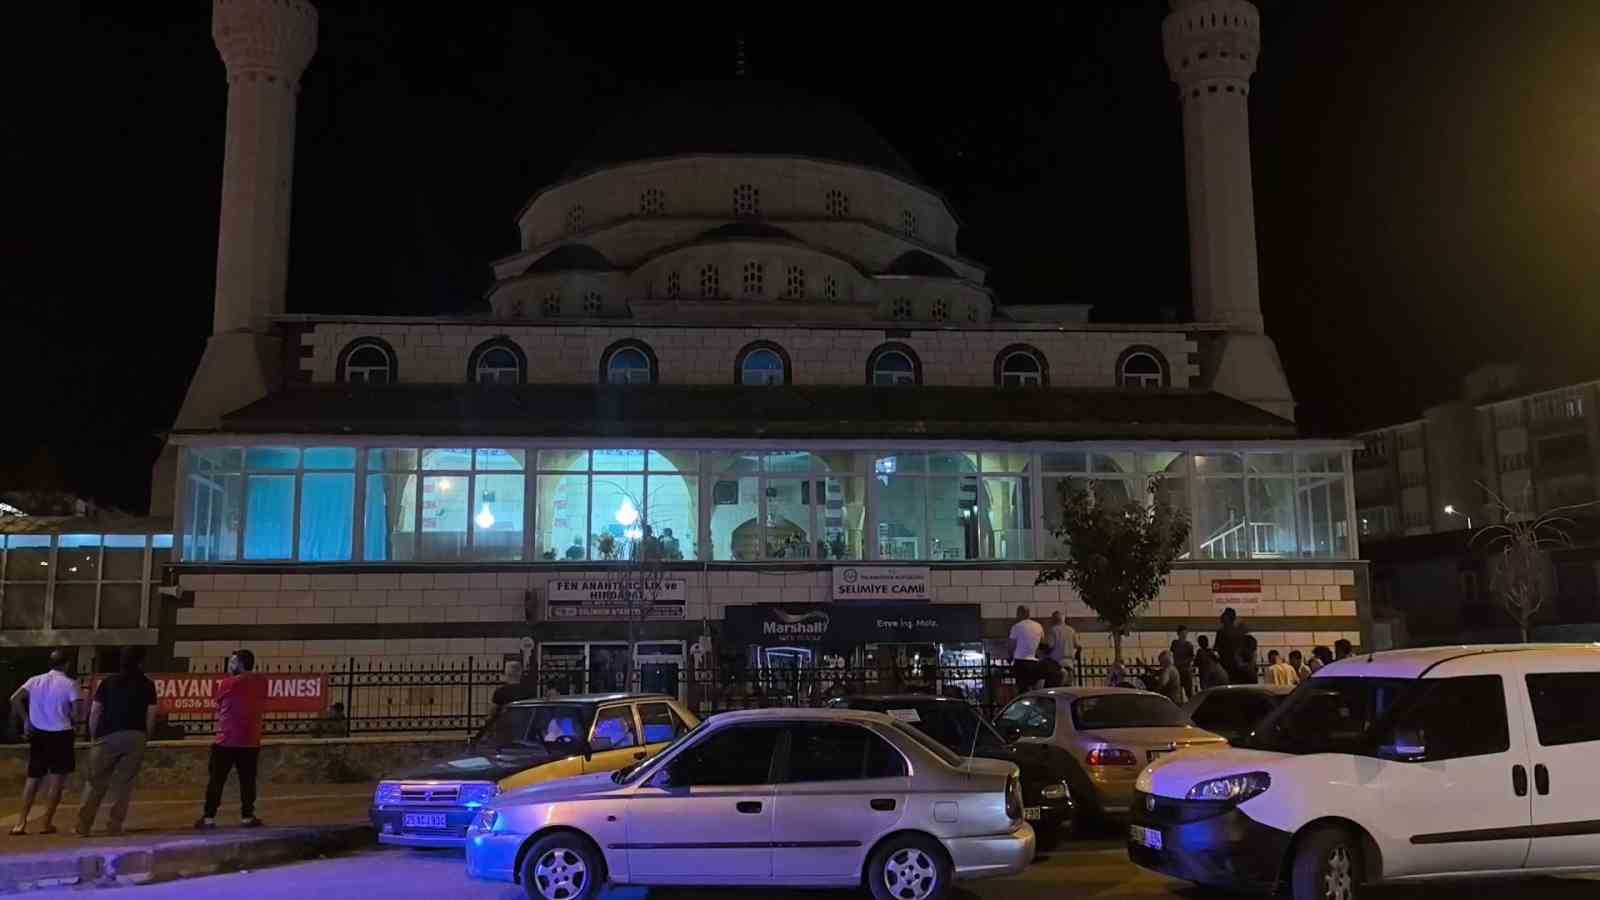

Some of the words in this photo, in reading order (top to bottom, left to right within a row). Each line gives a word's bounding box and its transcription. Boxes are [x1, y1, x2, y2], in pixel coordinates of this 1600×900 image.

[557, 581, 578, 591] FEN
[763, 621, 822, 633] Marshall
[153, 679, 213, 697] BAYAN
